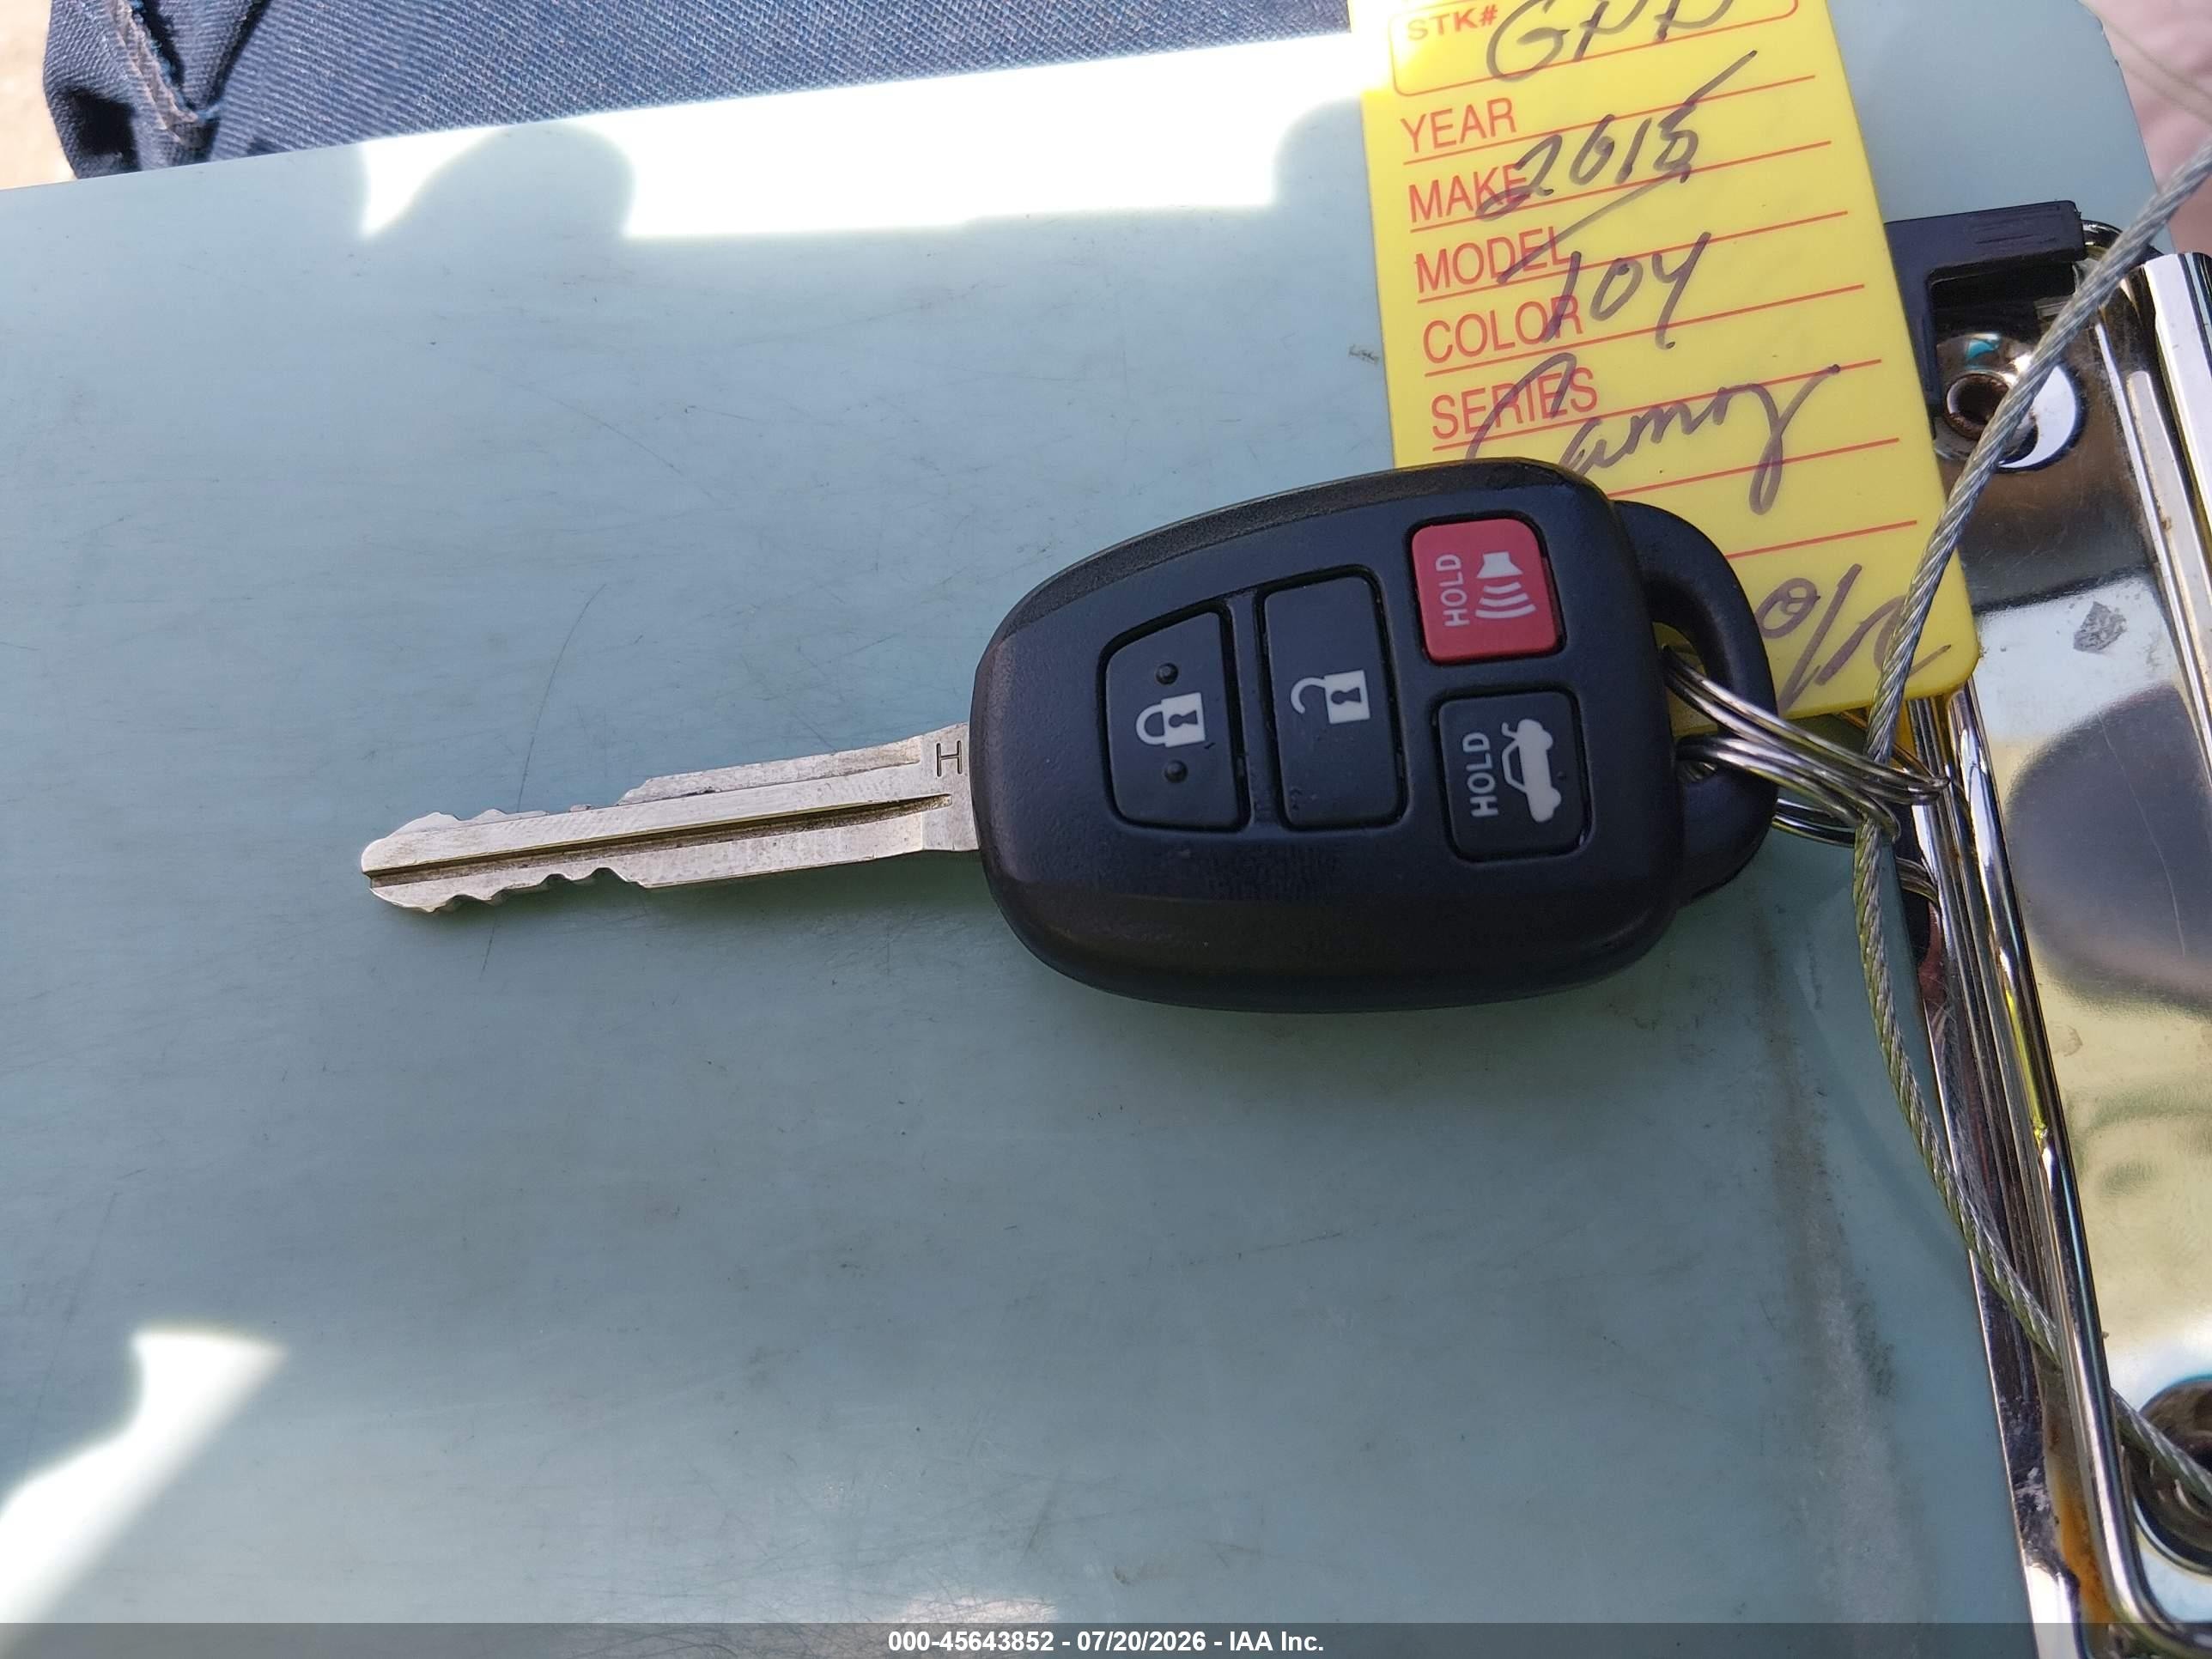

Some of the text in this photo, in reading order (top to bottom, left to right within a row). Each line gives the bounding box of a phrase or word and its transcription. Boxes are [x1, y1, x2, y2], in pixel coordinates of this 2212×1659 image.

[1406, 5, 1498, 41] STK#
[1401, 97, 1517, 153] YEAR
[1408, 162, 1531, 223] MAKE
[1415, 226, 1573, 294] MODEL
[1423, 295, 1583, 364] COLOR
[1431, 367, 1598, 440] SERIES
[1435, 554, 1470, 627] HOLD
[936, 740, 963, 777] H
[1462, 732, 1499, 817] HOLD
